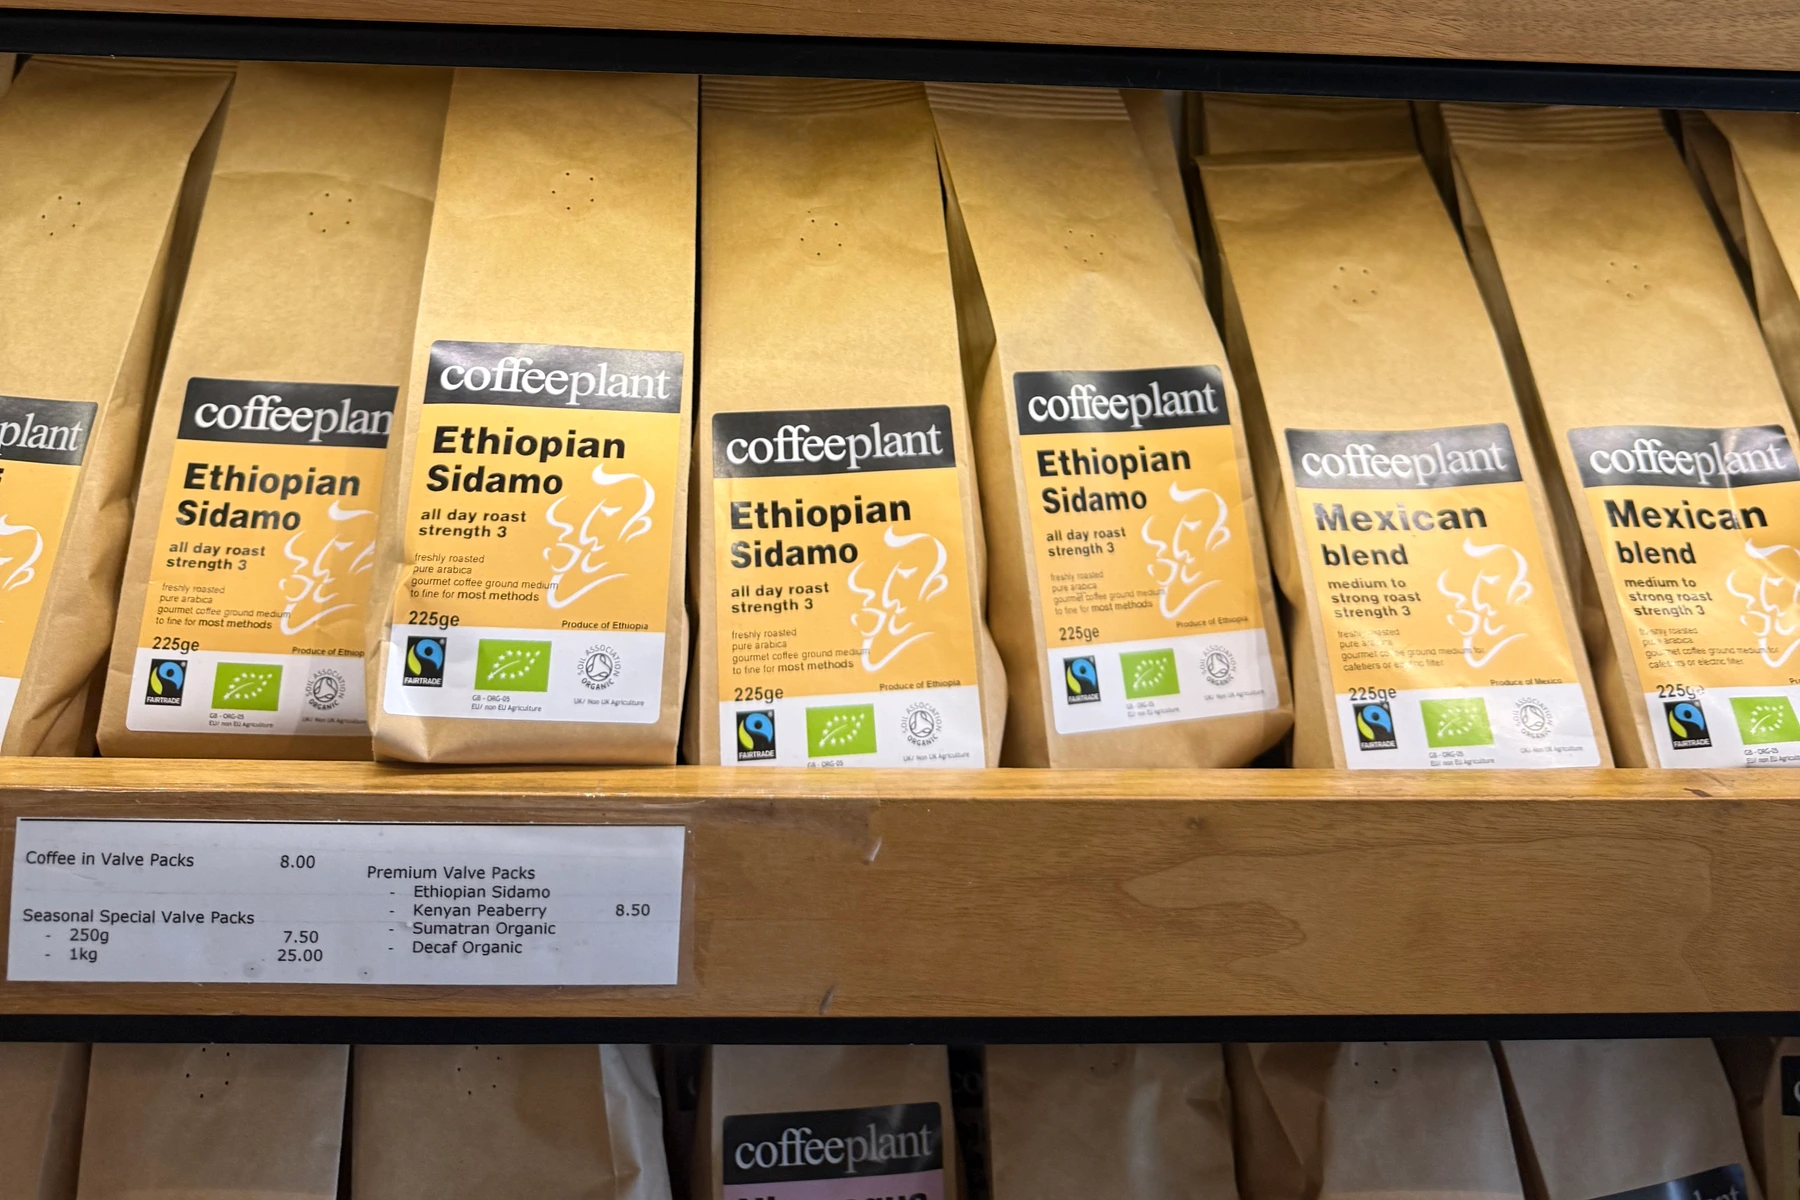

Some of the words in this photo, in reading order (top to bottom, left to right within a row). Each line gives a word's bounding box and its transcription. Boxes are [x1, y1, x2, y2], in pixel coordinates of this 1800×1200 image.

[440, 356, 670, 406] coffeeplant
[1028, 380, 1219, 427] coffeeplant
[194, 395, 392, 443] coffeeplan
[433, 425, 625, 463] Ethiopian
[726, 422, 944, 469] coffeeplant
[1036, 445, 1191, 480] Ethiopian
[1301, 442, 1508, 486] coffeeplant
[1589, 438, 1787, 485] coffeeplant
[184, 462, 361, 499] Ethiopian
[427, 464, 563, 495] Sidamo
[1041, 485, 1147, 515] Sidamo
[176, 500, 302, 531] Sidamo
[421, 509, 441, 520] all
[447, 509, 477, 523] day
[483, 510, 527, 522] roast
[730, 495, 911, 533] Ethiopian
[1313, 502, 1488, 531] Mexican
[1603, 499, 1768, 530] Mexican
[419, 525, 491, 539] strength
[497, 526, 507, 538] 3
[169, 542, 189, 555] all
[193, 542, 221, 558] day
[226, 544, 266, 557] roast
[415, 553, 445, 563] freshly
[449, 554, 485, 563] roasted
[730, 539, 858, 569] Sidamo
[1321, 543, 1409, 566] blend
[1615, 541, 1697, 564] blend
[167, 556, 233, 571] strength
[413, 565, 433, 574] pure
[437, 565, 472, 574] arabica
[411, 577, 451, 588] gourmet
[454, 578, 482, 587] coffee
[485, 580, 518, 589] ground
[521, 580, 558, 589] medium
[731, 585, 750, 597] all
[755, 584, 783, 598] day
[789, 582, 829, 595] roast
[1328, 578, 1387, 590] medium
[422, 589, 440, 598] fine
[457, 590, 486, 600] most
[489, 591, 539, 601] methods
[1331, 591, 1379, 605] strong
[1384, 591, 1421, 602] roast
[731, 600, 799, 614] strength
[804, 598, 813, 610] 3
[1334, 605, 1398, 620] strength
[408, 610, 459, 629] 225ge
[562, 620, 598, 629] Produce
[612, 621, 649, 630] Ethiopia
[1059, 626, 1100, 642] 225ge
[152, 636, 200, 654] 225ge
[404, 676, 442, 685] FAIRTRADE
[581, 678, 615, 691] ORGANIC
[147, 696, 181, 704] FAIRTRADE
[734, 687, 784, 704] 225ge
[739, 750, 775, 758] FAIRTRADE
[25, 851, 76, 865] Coffee
[82, 852, 95, 865] in
[101, 853, 144, 867] Valve
[150, 854, 194, 867] Packs
[280, 856, 315, 868] 8.00
[368, 866, 437, 879] Premium
[444, 866, 485, 879] Valve
[492, 867, 535, 879] Packs
[414, 886, 486, 900] Ethiopian
[492, 886, 550, 898] Sidamo
[23, 909, 94, 923] Seasonal
[100, 910, 156, 927] Special
[161, 911, 204, 924] Valve
[212, 912, 254, 924] Packs
[413, 904, 471, 919] Kenyan
[478, 904, 547, 919] Peaberry
[616, 904, 650, 916] 8.50
[69, 928, 109, 944] 250g
[283, 930, 319, 943] 7.50
[413, 922, 489, 934] Sumatran
[496, 922, 556, 937] Organic
[69, 948, 98, 963] 1kg
[277, 950, 323, 962] 25.00
[413, 941, 457, 953] Decaf
[462, 942, 522, 955] Organic
[735, 1123, 932, 1173] coffeeplant
